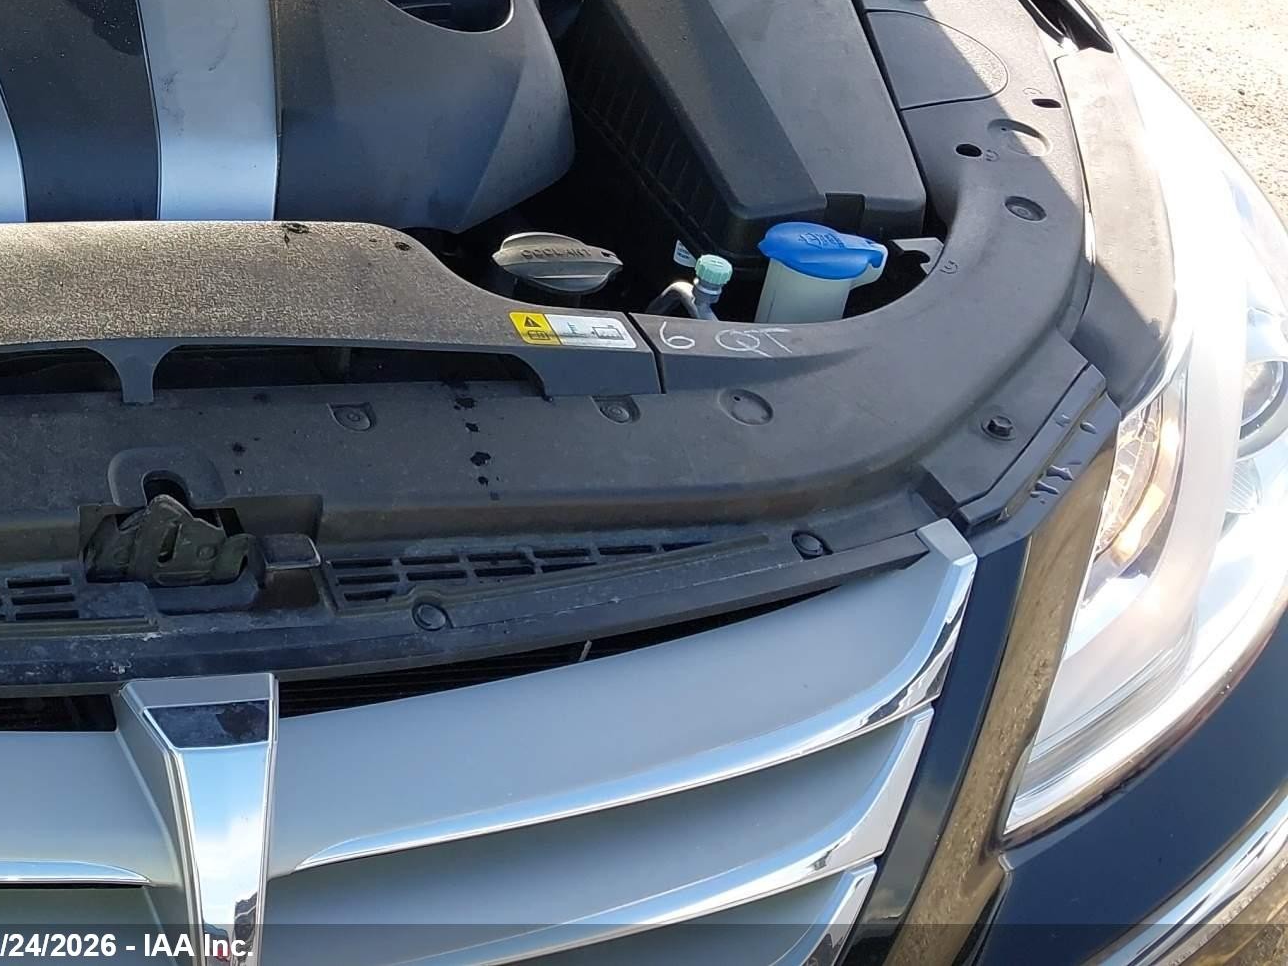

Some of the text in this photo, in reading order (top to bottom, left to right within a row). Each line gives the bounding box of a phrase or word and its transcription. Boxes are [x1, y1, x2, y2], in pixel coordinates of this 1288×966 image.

[520, 247, 592, 260] COOLANT
[659, 321, 793, 359] 6 QT
